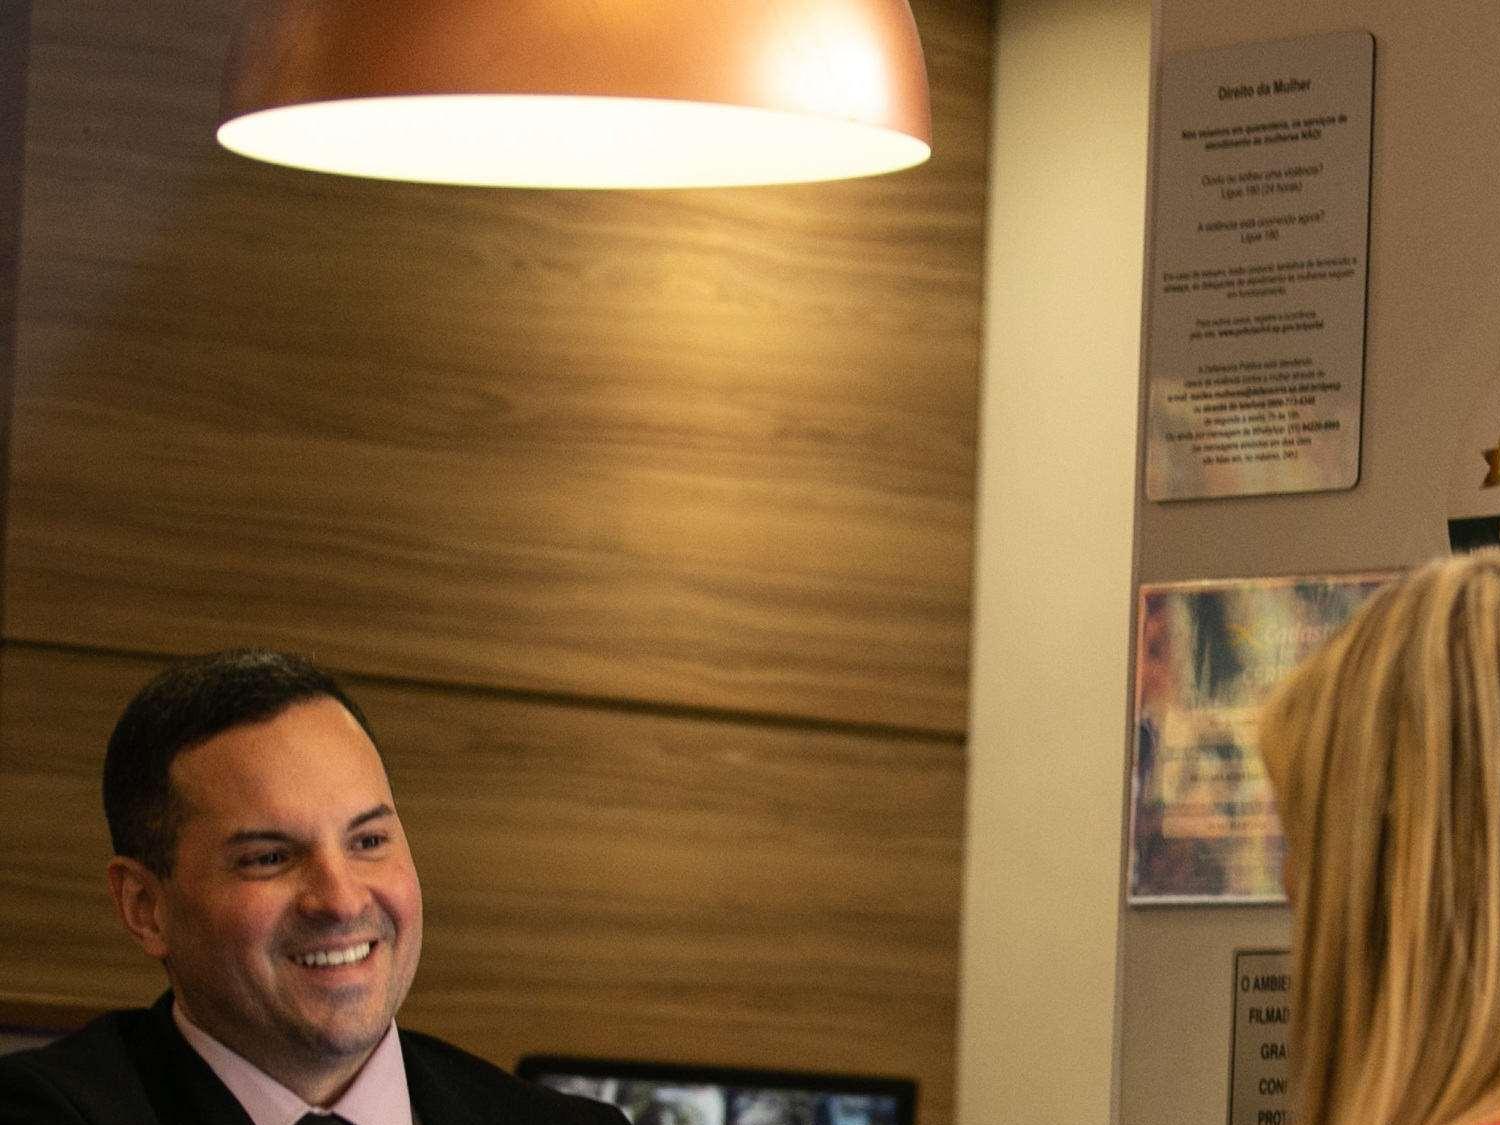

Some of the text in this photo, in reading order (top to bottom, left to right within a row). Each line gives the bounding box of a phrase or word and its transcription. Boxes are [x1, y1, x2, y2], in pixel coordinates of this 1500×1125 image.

[1272, 78, 1311, 95] Mulher
[1240, 976, 1251, 992] O
[1249, 1008, 1290, 1025] FILMAD
[1260, 1043, 1288, 1060] GRA
